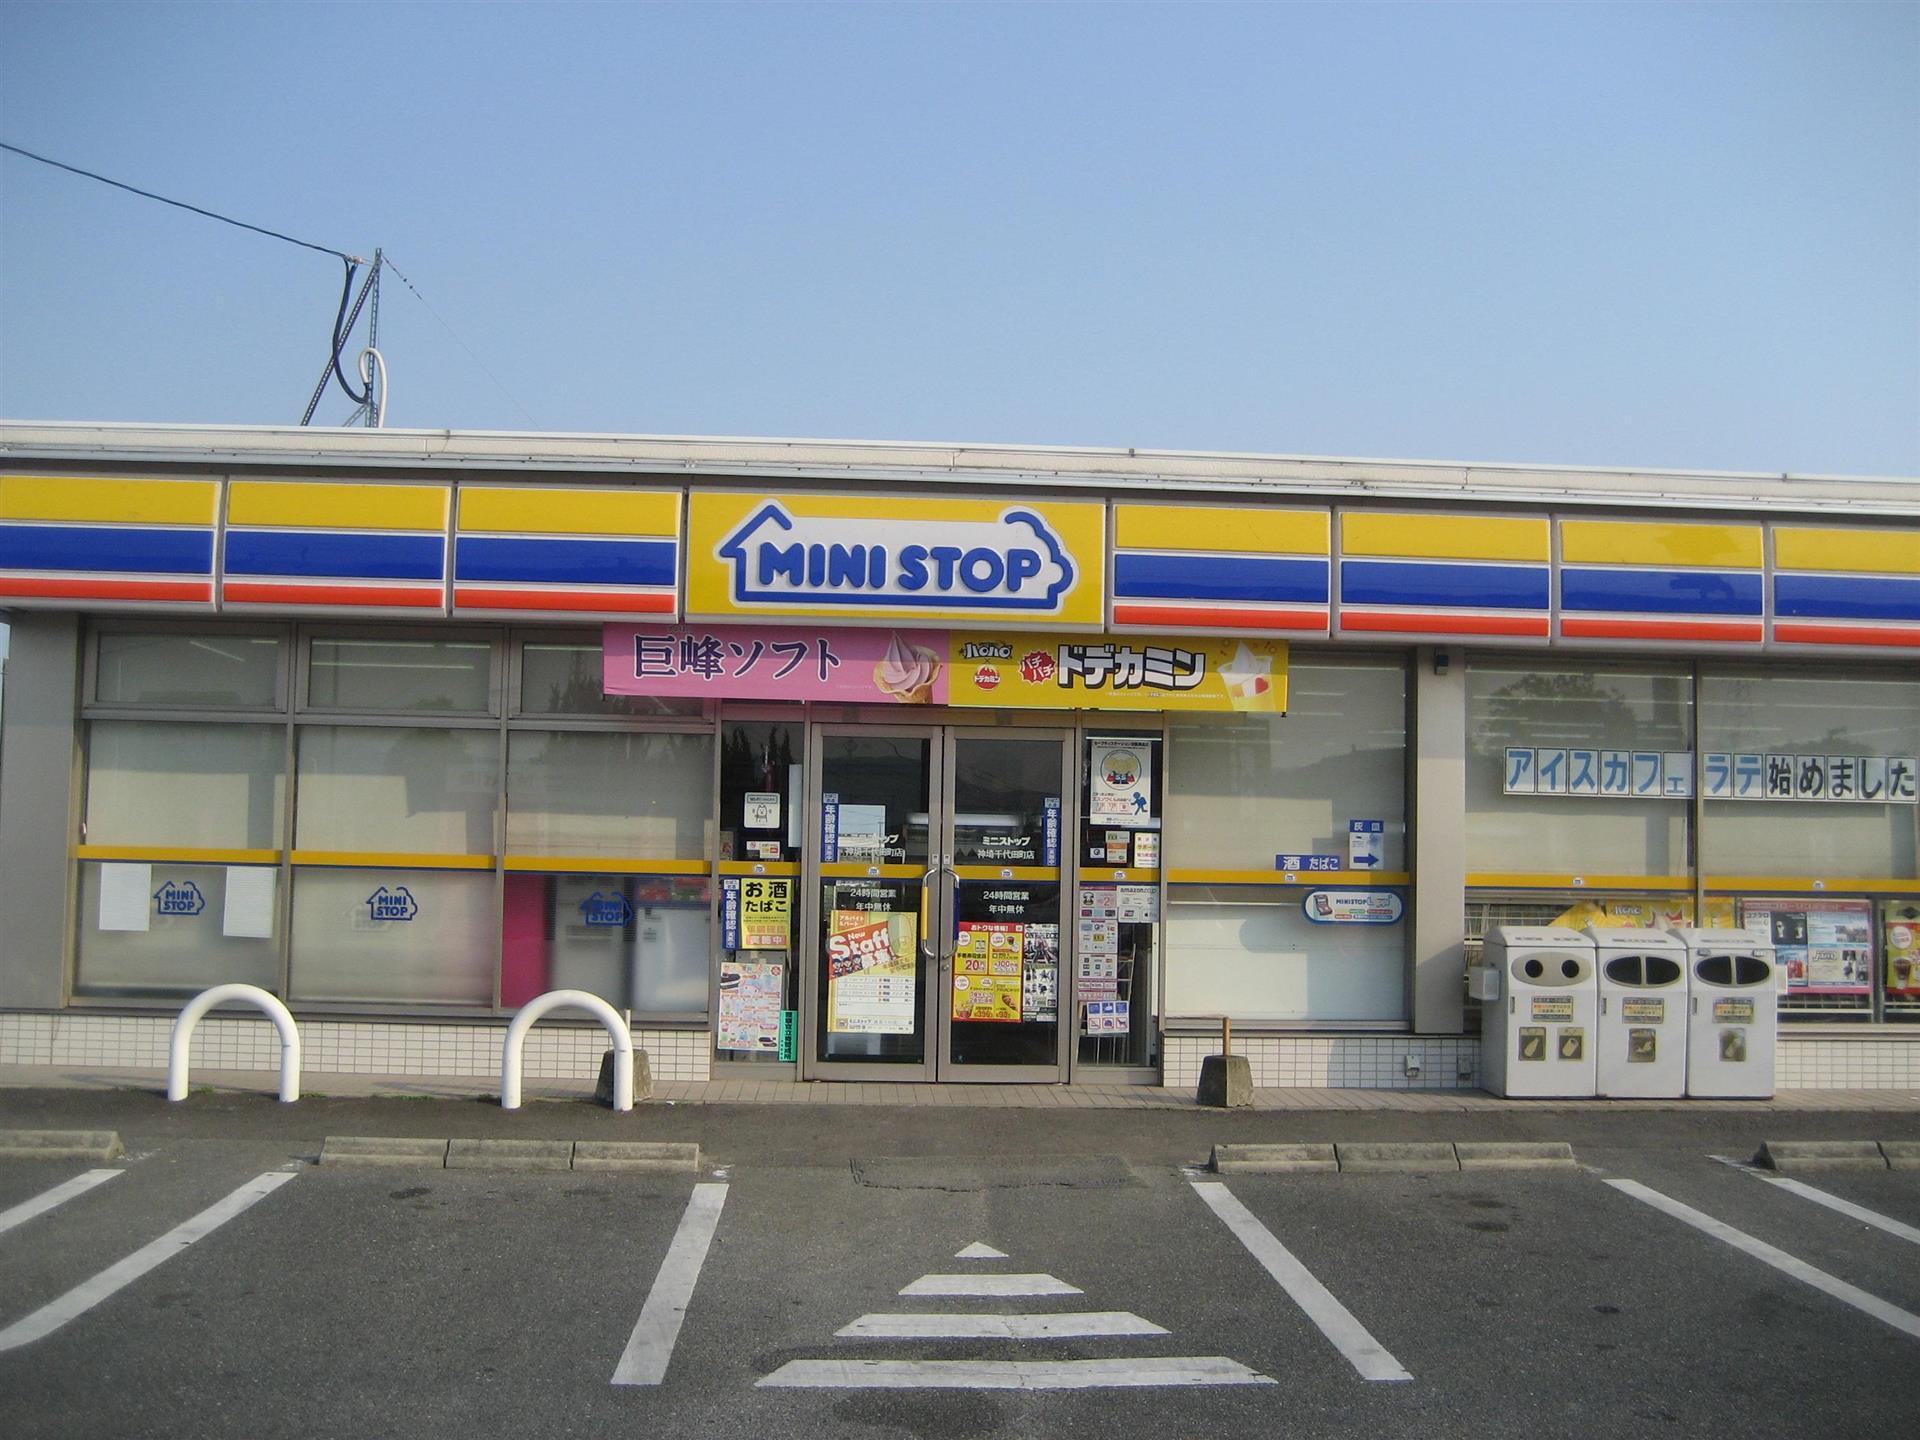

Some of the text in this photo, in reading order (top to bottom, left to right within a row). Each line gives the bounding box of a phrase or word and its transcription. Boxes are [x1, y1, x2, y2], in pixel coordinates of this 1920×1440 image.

[759, 541, 1042, 592] MINI STOP
[634, 634, 841, 681] 巨峰ソフト
[1021, 655, 1043, 672] パチ
[1058, 643, 1206, 690] ドデカミン
[1032, 663, 1055, 680] パチ
[982, 836, 1031, 846] ミニストップ
[1283, 856, 1339, 870] 酒 たばこ
[165, 889, 194, 900] MINI
[745, 881, 788, 899] お酒
[850, 888, 897, 898] 24時間営業
[983, 890, 1030, 901] 24時間営業
[163, 901, 195, 911] STOP
[378, 895, 407, 906] MINI
[376, 906, 408, 916] STOP
[745, 900, 788, 913] たばこ
[855, 902, 892, 912] 年中無休
[988, 904, 1025, 914] 年中無休
[848, 931, 866, 941] New
[829, 927, 889, 960] Staff
